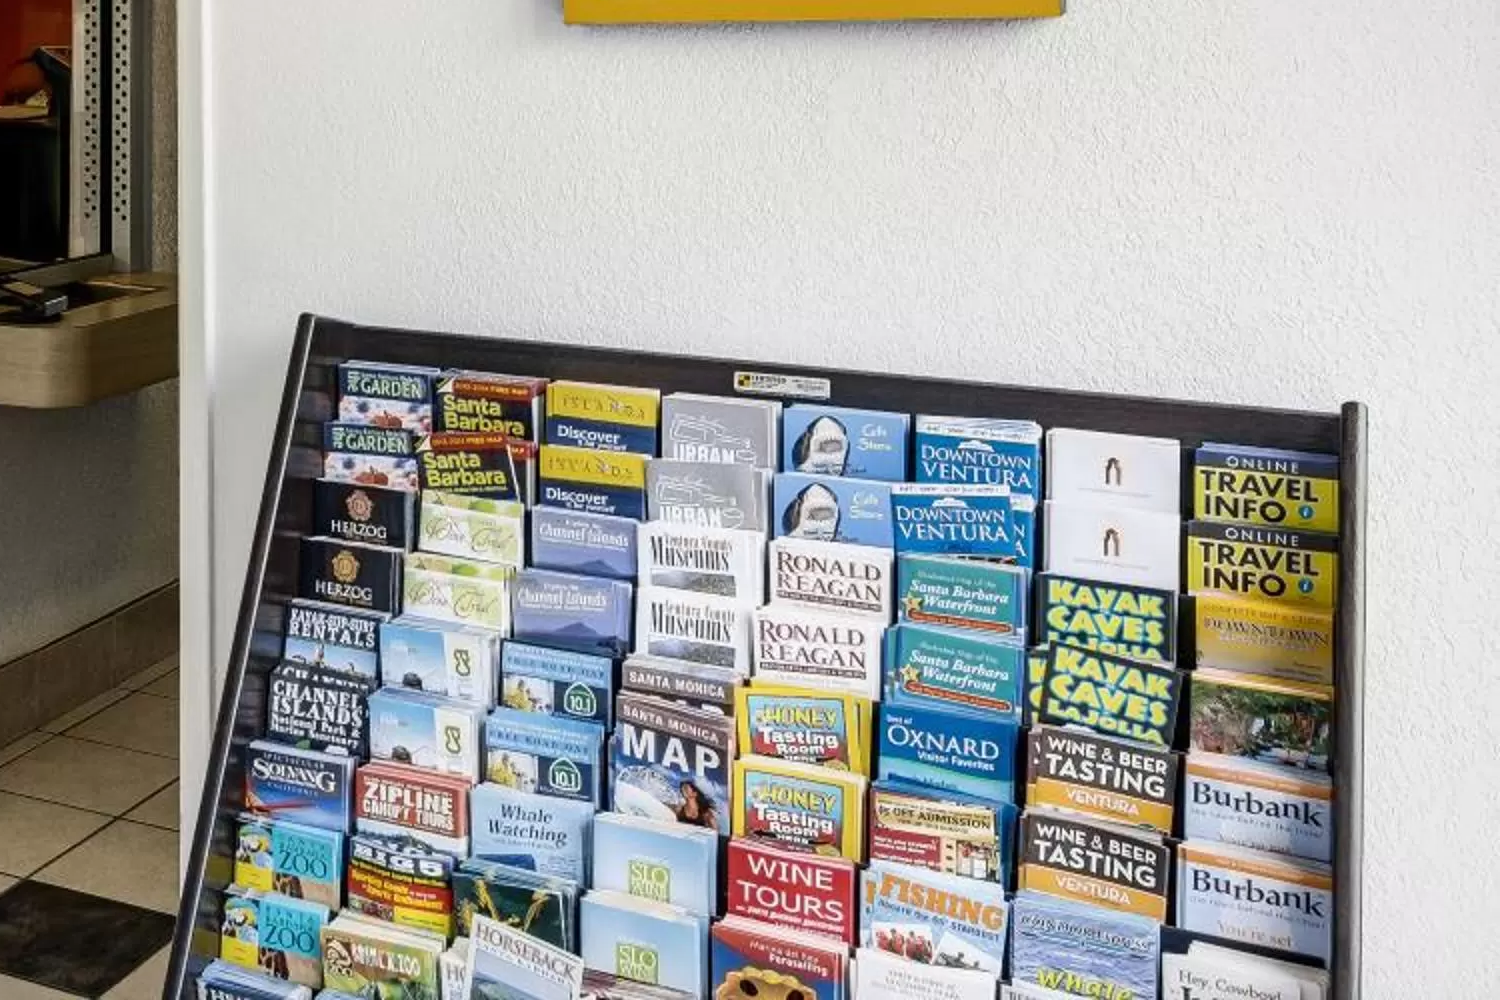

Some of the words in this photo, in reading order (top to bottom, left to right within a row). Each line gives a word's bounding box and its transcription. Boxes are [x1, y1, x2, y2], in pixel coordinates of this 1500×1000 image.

[361, 377, 425, 399] GARDEN
[443, 394, 500, 417] Santa
[444, 411, 525, 438] Barbara
[557, 424, 621, 444] Discover
[345, 434, 410, 455] GARDEN
[673, 442, 735, 463] URBAN
[922, 444, 1031, 470] DOWNTOWN
[424, 451, 481, 470] Santa
[1225, 455, 1299, 473] ONLINE
[427, 468, 507, 488] Barbara
[923, 463, 1032, 488] VENTURA
[1200, 469, 1319, 503] TRAVEL
[545, 487, 609, 505] Discover
[1203, 494, 1288, 523] INFO
[659, 504, 722, 528] URBAN
[896, 504, 1005, 523] DOWNTOWN
[330, 519, 387, 539] HERZOG
[899, 522, 1010, 542] VENTURA
[1225, 526, 1299, 547] ONLINE
[651, 535, 729, 571] Museums
[777, 551, 882, 581] RONALD
[1199, 541, 1319, 577] TRAVEL
[315, 579, 373, 601] HERZOG
[777, 576, 882, 601] REAGAN
[910, 578, 949, 596] Santa
[952, 585, 1009, 604] Barbara
[1203, 567, 1287, 598] INFO
[924, 593, 997, 616] Waterfront
[1050, 579, 1166, 618] KAYAK
[288, 620, 376, 649] RENTALS
[651, 601, 731, 643] Museums
[759, 618, 865, 647] RONALD
[1047, 606, 1165, 645] CAVES
[760, 642, 866, 669] REAGAN
[909, 650, 948, 668] Santa
[952, 660, 1009, 682] Barbara
[628, 671, 671, 690] SANTA
[675, 679, 725, 699] MONICA
[922, 666, 997, 693] Waterfront
[1054, 646, 1172, 699] KAYAK
[273, 680, 363, 709] CHANNEL
[1050, 677, 1168, 727] CAVES
[271, 695, 363, 728] ISLANDS
[622, 704, 663, 727] SANTA
[667, 715, 720, 745] MONICA
[764, 705, 838, 729] HONEY
[271, 713, 316, 731] National
[320, 720, 347, 737] Park
[351, 729, 361, 740] &
[759, 726, 839, 750] Tasting
[1084, 708, 1164, 745] JOLLA
[622, 723, 721, 778] MAP
[776, 742, 825, 756] Room
[887, 725, 1000, 760] OXNARD
[1047, 735, 1097, 759] WINE
[1101, 747, 1113, 763] &
[1119, 752, 1168, 776] BEER
[917, 751, 949, 766] Visitor
[951, 756, 996, 772] Favorites
[1045, 753, 1166, 798] TASTING
[363, 780, 454, 816] ZIPLINE
[760, 783, 837, 813] HONEY
[1066, 786, 1140, 817] VENTURA
[1191, 779, 1323, 828] Burbank
[501, 803, 553, 824] Whale
[754, 803, 834, 833] Tasting
[893, 806, 915, 821] OFF
[918, 809, 992, 830] ADMISSION
[488, 819, 568, 847] Watching
[769, 821, 819, 838] Room
[1036, 821, 1086, 848] WINE
[1090, 834, 1102, 850] &
[1108, 839, 1158, 867] BEER
[279, 852, 328, 878] ZOO
[631, 863, 669, 886] SLO
[747, 854, 833, 891] WINE
[1033, 838, 1157, 889] TASTING
[736, 880, 845, 923] TOURS
[879, 872, 1005, 931] FISHING
[1054, 874, 1132, 906] VENTURA
[1191, 868, 1324, 919] Burbank
[263, 925, 315, 954] ZOO
[476, 922, 580, 982] HORSEBACK
[618, 944, 656, 968] SLO
[1036, 966, 1136, 1000] Whale
